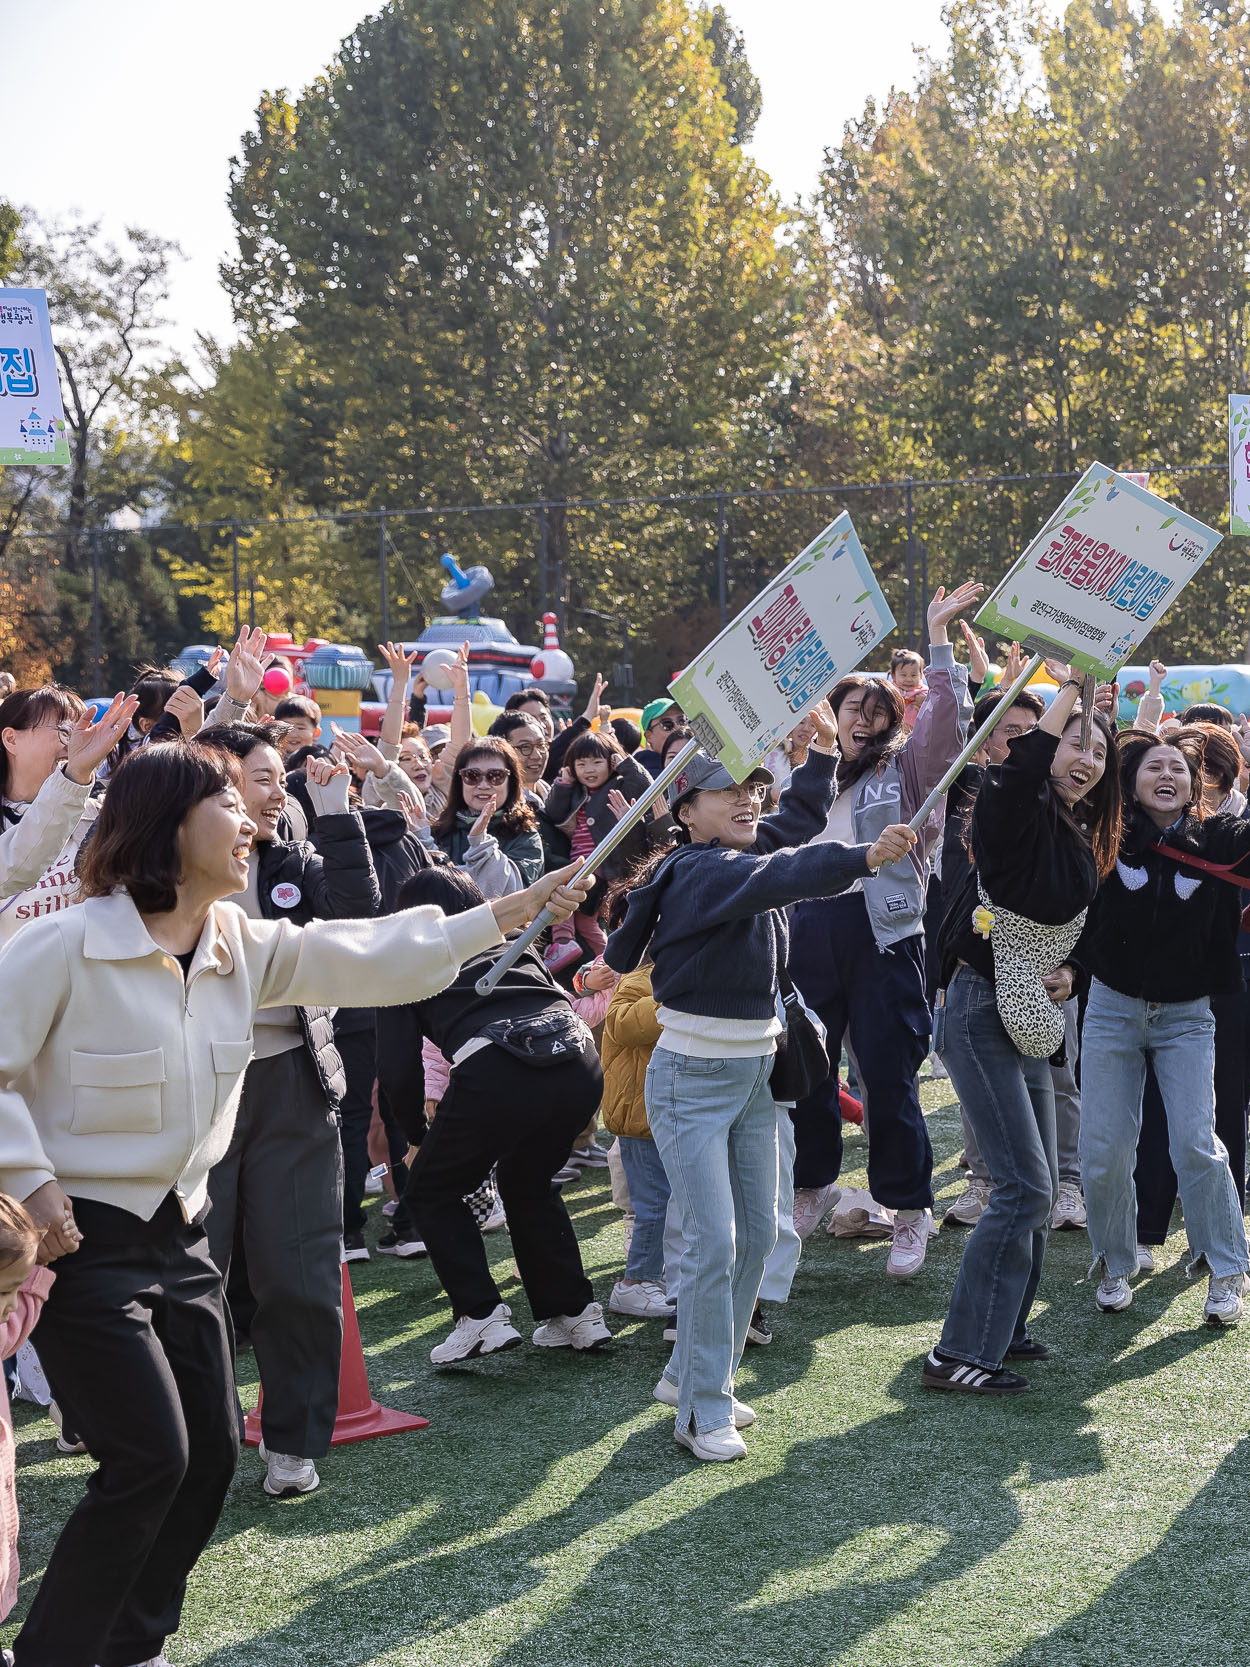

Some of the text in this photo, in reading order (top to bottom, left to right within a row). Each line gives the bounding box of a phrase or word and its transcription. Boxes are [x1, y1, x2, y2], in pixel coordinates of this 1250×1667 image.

[0, 347, 36, 393] 집
[1030, 599, 1108, 643] 광진구가정어린이집연합회
[716, 671, 762, 732] 광진구가정어린이집연합회
